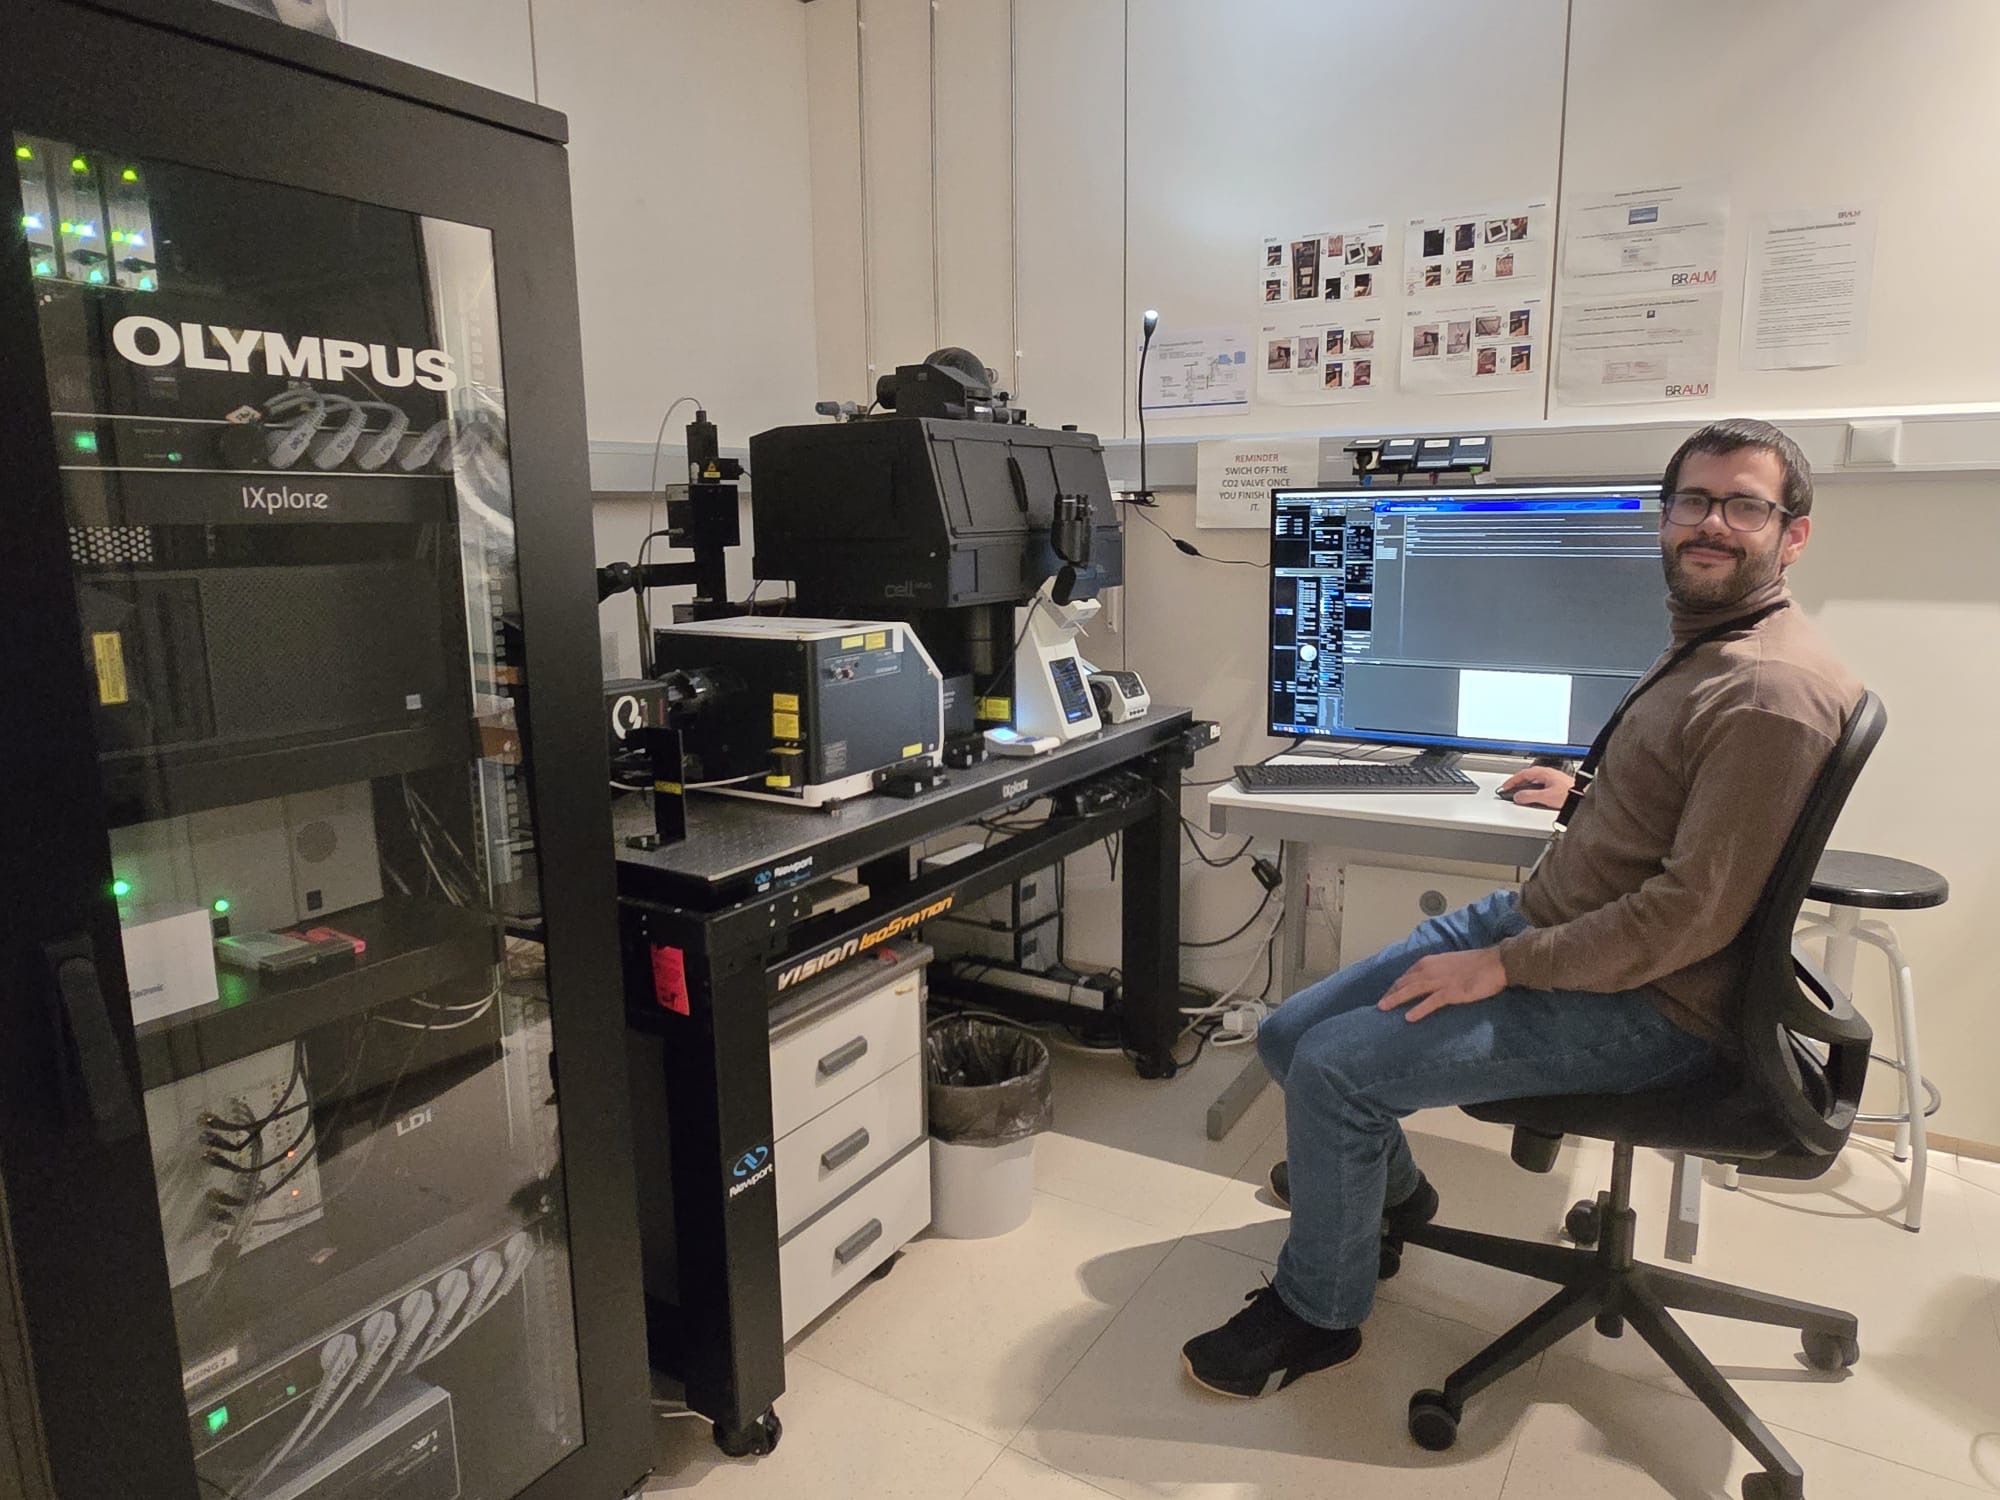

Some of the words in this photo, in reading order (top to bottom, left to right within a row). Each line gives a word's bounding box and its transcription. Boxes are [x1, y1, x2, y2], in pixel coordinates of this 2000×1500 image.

[1672, 271, 1717, 285] BRALM
[112, 316, 457, 391] OLYMPUS
[1665, 384, 1709, 396] BRALM
[1235, 454, 1279, 463] REMINDER
[1225, 467, 1252, 475] SWICH
[1254, 466, 1270, 474] OFF
[1272, 466, 1288, 474] THE
[1222, 480, 1239, 488] CO2
[1240, 479, 1265, 488] VALVE
[1267, 479, 1291, 487] ONCE
[242, 486, 328, 515] IXplore
[1219, 492, 1236, 500] YOU
[1238, 491, 1265, 500] FINISH
[395, 1107, 432, 1137] LDI
[729, 1163, 773, 1198] Newport
